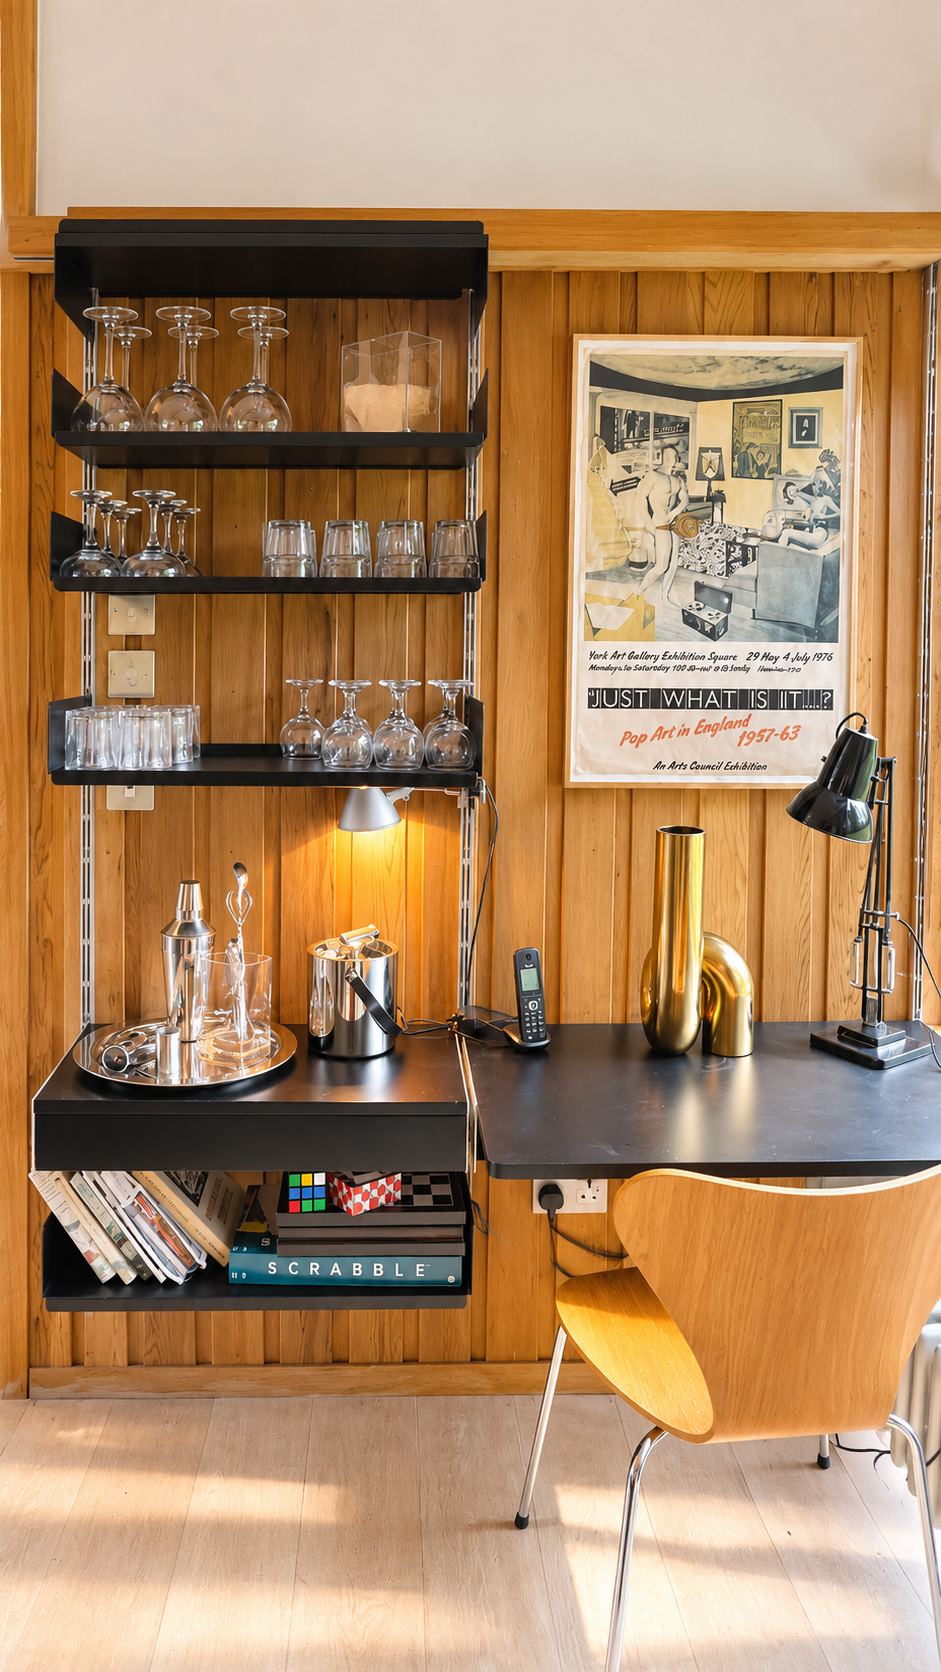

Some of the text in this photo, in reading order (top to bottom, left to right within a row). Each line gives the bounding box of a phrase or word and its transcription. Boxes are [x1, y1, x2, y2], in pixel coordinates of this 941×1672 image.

[588, 650, 608, 661] York
[609, 650, 627, 660] Art
[627, 650, 660, 664] Gallery
[661, 651, 706, 661] Exhibition
[707, 651, 738, 664] Square
[746, 651, 760, 661] 29
[782, 652, 791, 662] 4
[791, 652, 811, 666] July
[812, 652, 834, 662] 1976
[662, 690, 737, 709] WHAT
[751, 690, 767, 709] IS
[619, 713, 752, 749] Pop Art in England
[737, 724, 802, 748] 1957-63
[652, 760, 768, 771] An Arts Council Exhibition
[267, 1261, 426, 1277] SCRABBLE
